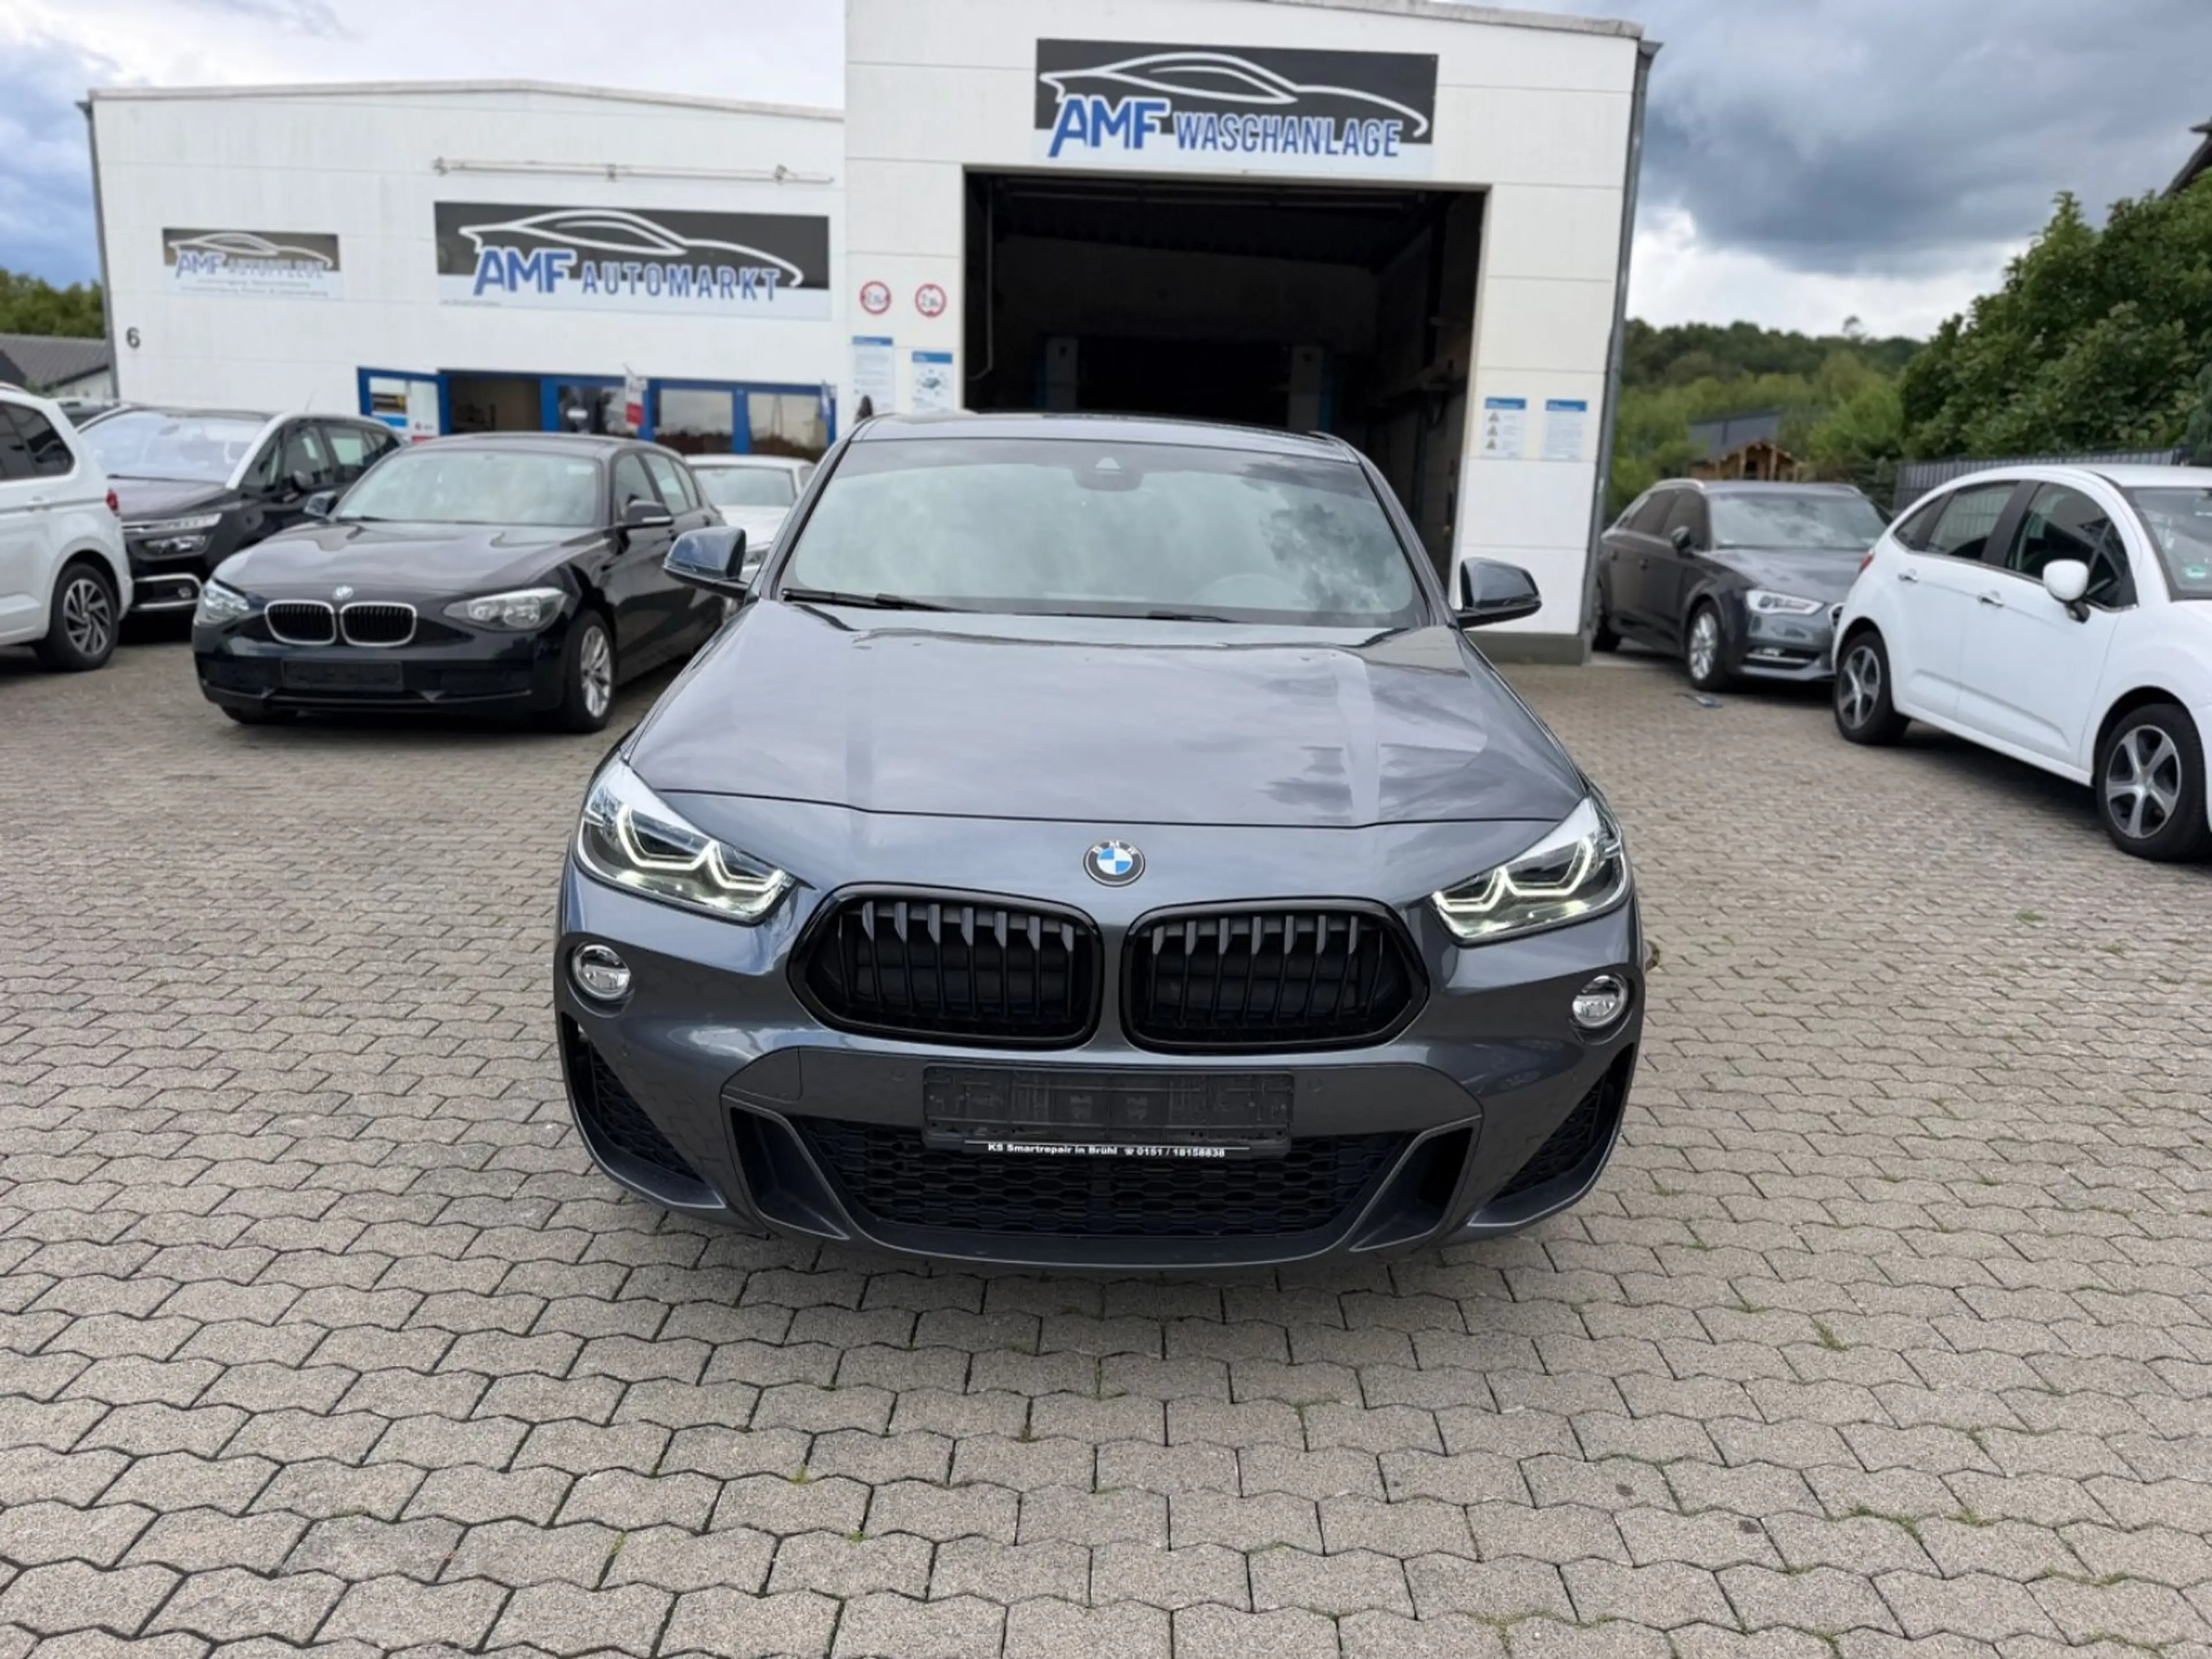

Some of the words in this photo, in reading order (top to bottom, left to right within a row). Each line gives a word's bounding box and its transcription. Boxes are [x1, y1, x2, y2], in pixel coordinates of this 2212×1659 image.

[1048, 98, 1168, 157] AMF
[1174, 112, 1402, 157] WASCHANLAGE
[176, 251, 225, 278] AMF
[473, 249, 574, 296] AMF
[581, 262, 781, 302] AUTOMARKT
[126, 326, 141, 349] 6
[1006, 1143, 1073, 1155] Smartrepair
[1075, 1145, 1085, 1154] in
[1089, 1145, 1118, 1156] Brühl
